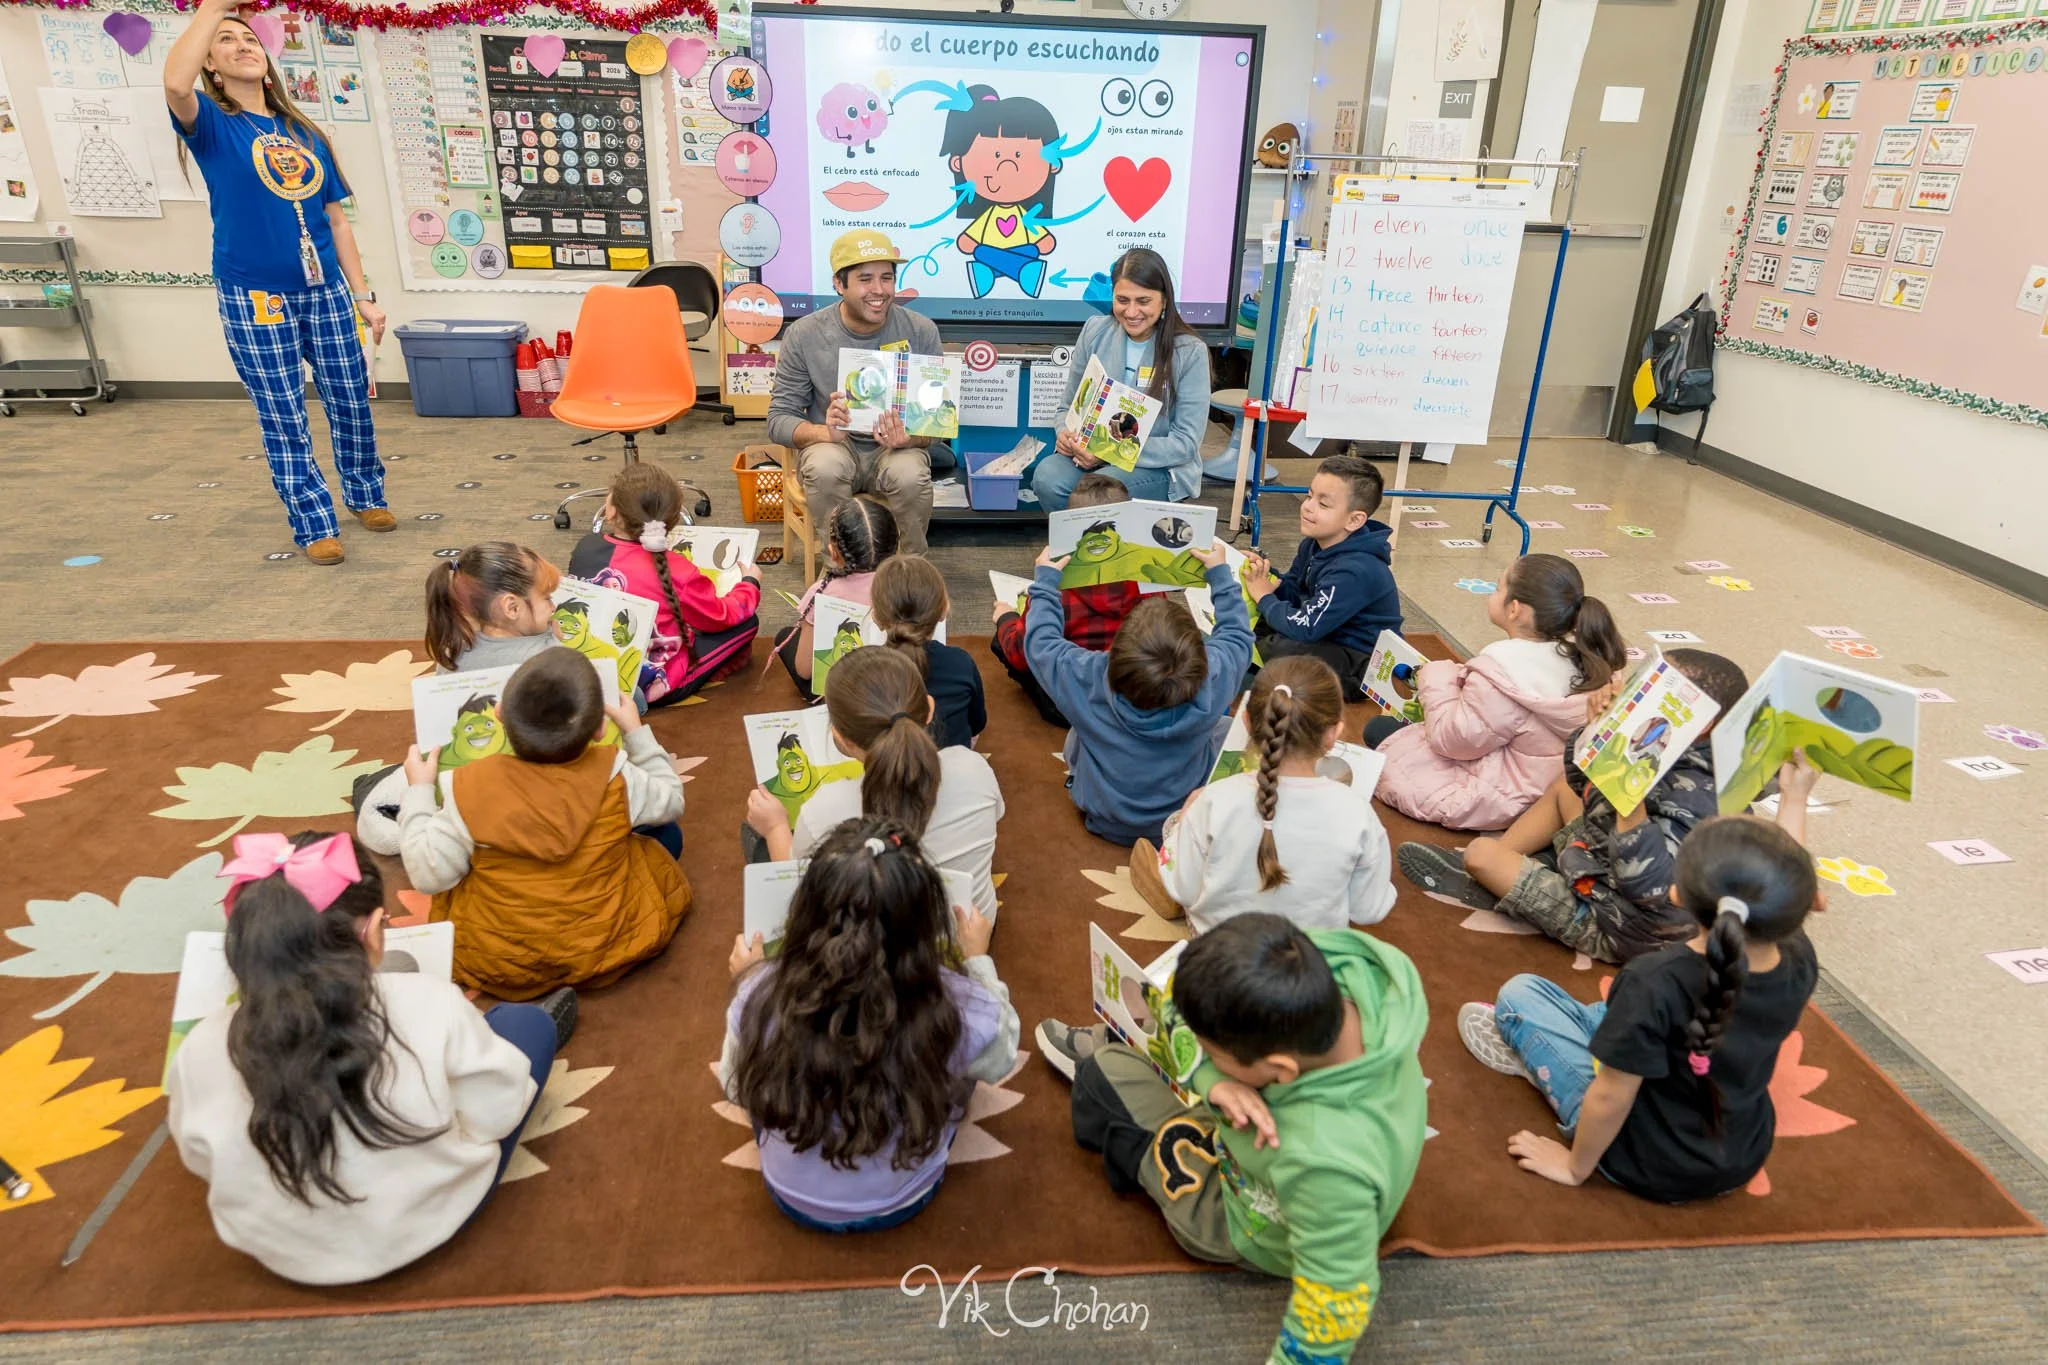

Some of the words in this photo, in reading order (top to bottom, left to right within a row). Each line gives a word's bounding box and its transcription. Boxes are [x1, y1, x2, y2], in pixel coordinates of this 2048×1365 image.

[1138, 2, 1143, 11] 7
[1150, 7, 1155, 15] 6
[1162, 3, 1167, 11] 5
[911, 31, 930, 53] el
[940, 37, 1018, 62] cuerpo
[1028, 39, 1159, 63] escuchando
[578, 50, 608, 61] Clima
[516, 60, 523, 70] 6
[606, 67, 621, 75] 2026
[1445, 92, 1472, 104] EXIT
[1107, 126, 1123, 135] ojos
[1125, 127, 1149, 135] estan
[1151, 128, 1184, 136] mirando
[606, 137, 616, 146] 14
[607, 156, 616, 164] 21
[823, 166, 832, 174] El
[835, 167, 857, 175] cebro
[882, 168, 920, 177] enfocado
[822, 218, 845, 227] labios
[1342, 210, 1357, 235] 11
[1374, 209, 1426, 235] elven
[1777, 215, 1788, 235] 6
[1106, 229, 1114, 237] el
[857, 240, 872, 249] DO
[861, 247, 888, 256] GOOD
[1337, 247, 1356, 268] 12
[1374, 245, 1433, 270] twelve
[1332, 276, 1352, 295] 13
[1368, 280, 1416, 304] trece
[985, 309, 1002, 317] pies
[1004, 309, 1044, 317] tranquilos
[1328, 304, 1343, 323] 14
[1322, 353, 1340, 373] 16
[1320, 384, 1339, 405] 17
[1963, 761, 2004, 771] ha
[1952, 845, 1984, 857] te
